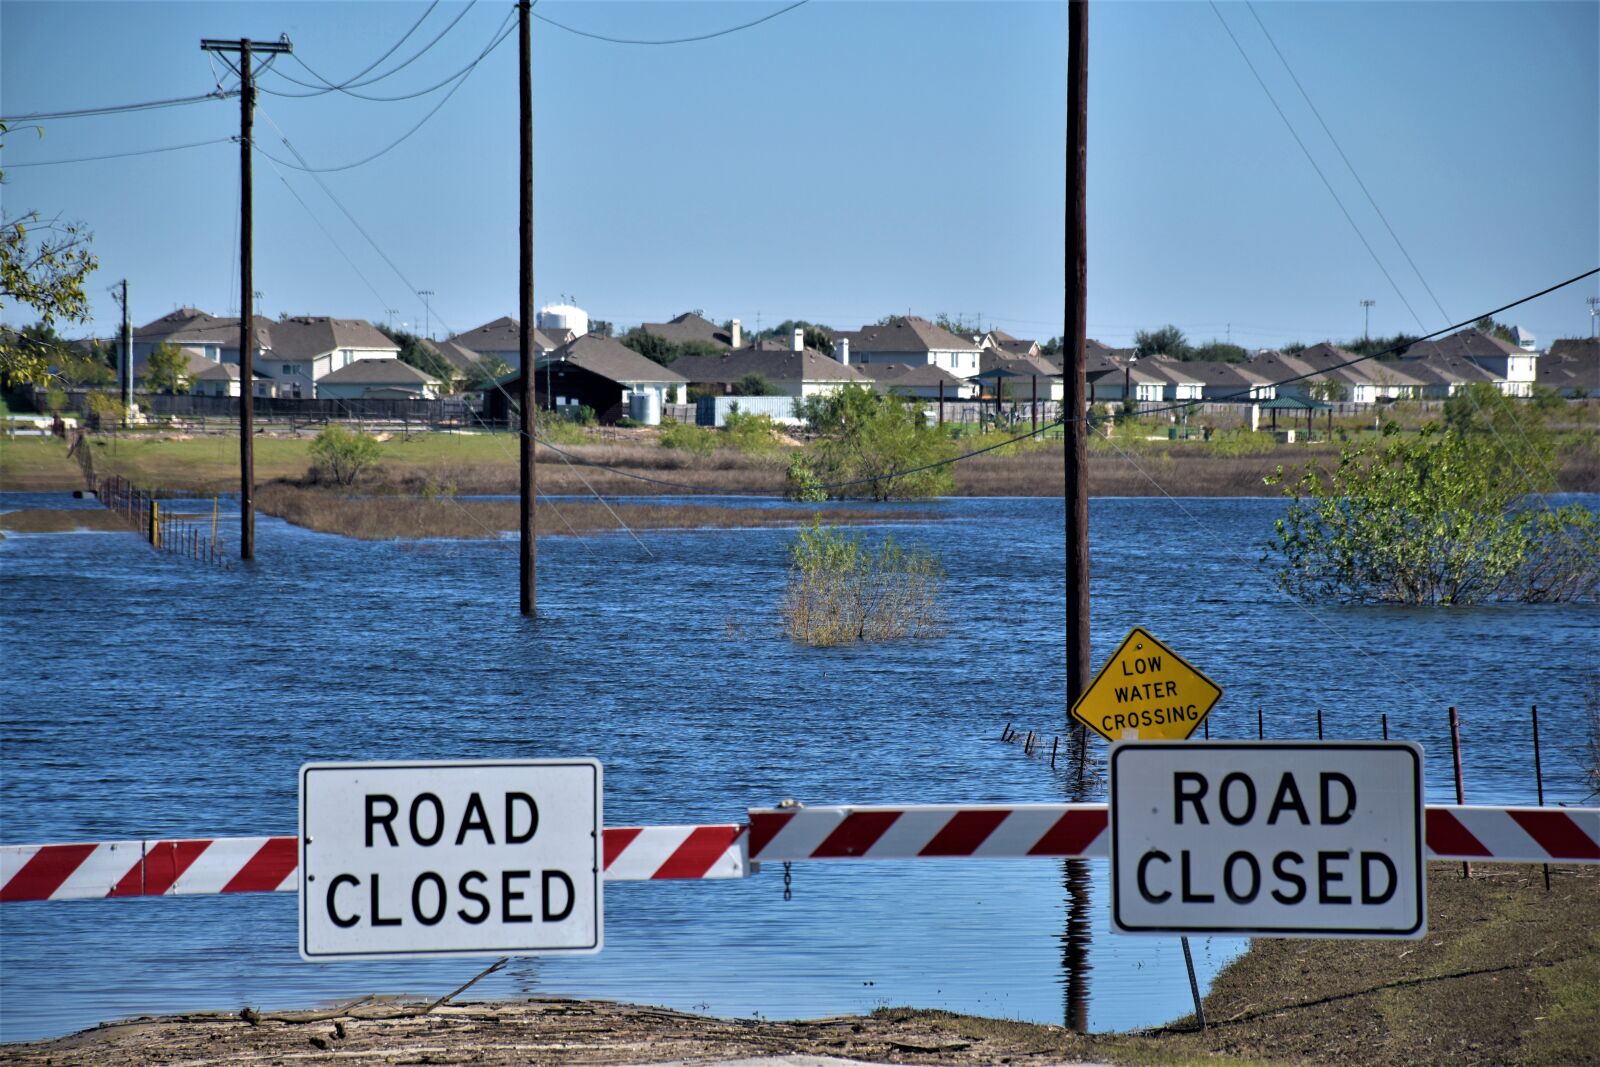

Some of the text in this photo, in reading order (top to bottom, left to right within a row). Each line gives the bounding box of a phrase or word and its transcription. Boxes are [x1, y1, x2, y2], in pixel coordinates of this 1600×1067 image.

[1115, 681, 1177, 703] WATER
[1122, 656, 1161, 676] LOW
[1102, 704, 1198, 731] CROSSING
[365, 792, 539, 847] ROAD
[1173, 771, 1358, 827] ROAD
[327, 869, 576, 928] CLOSED
[1136, 848, 1398, 906] CLOSED
